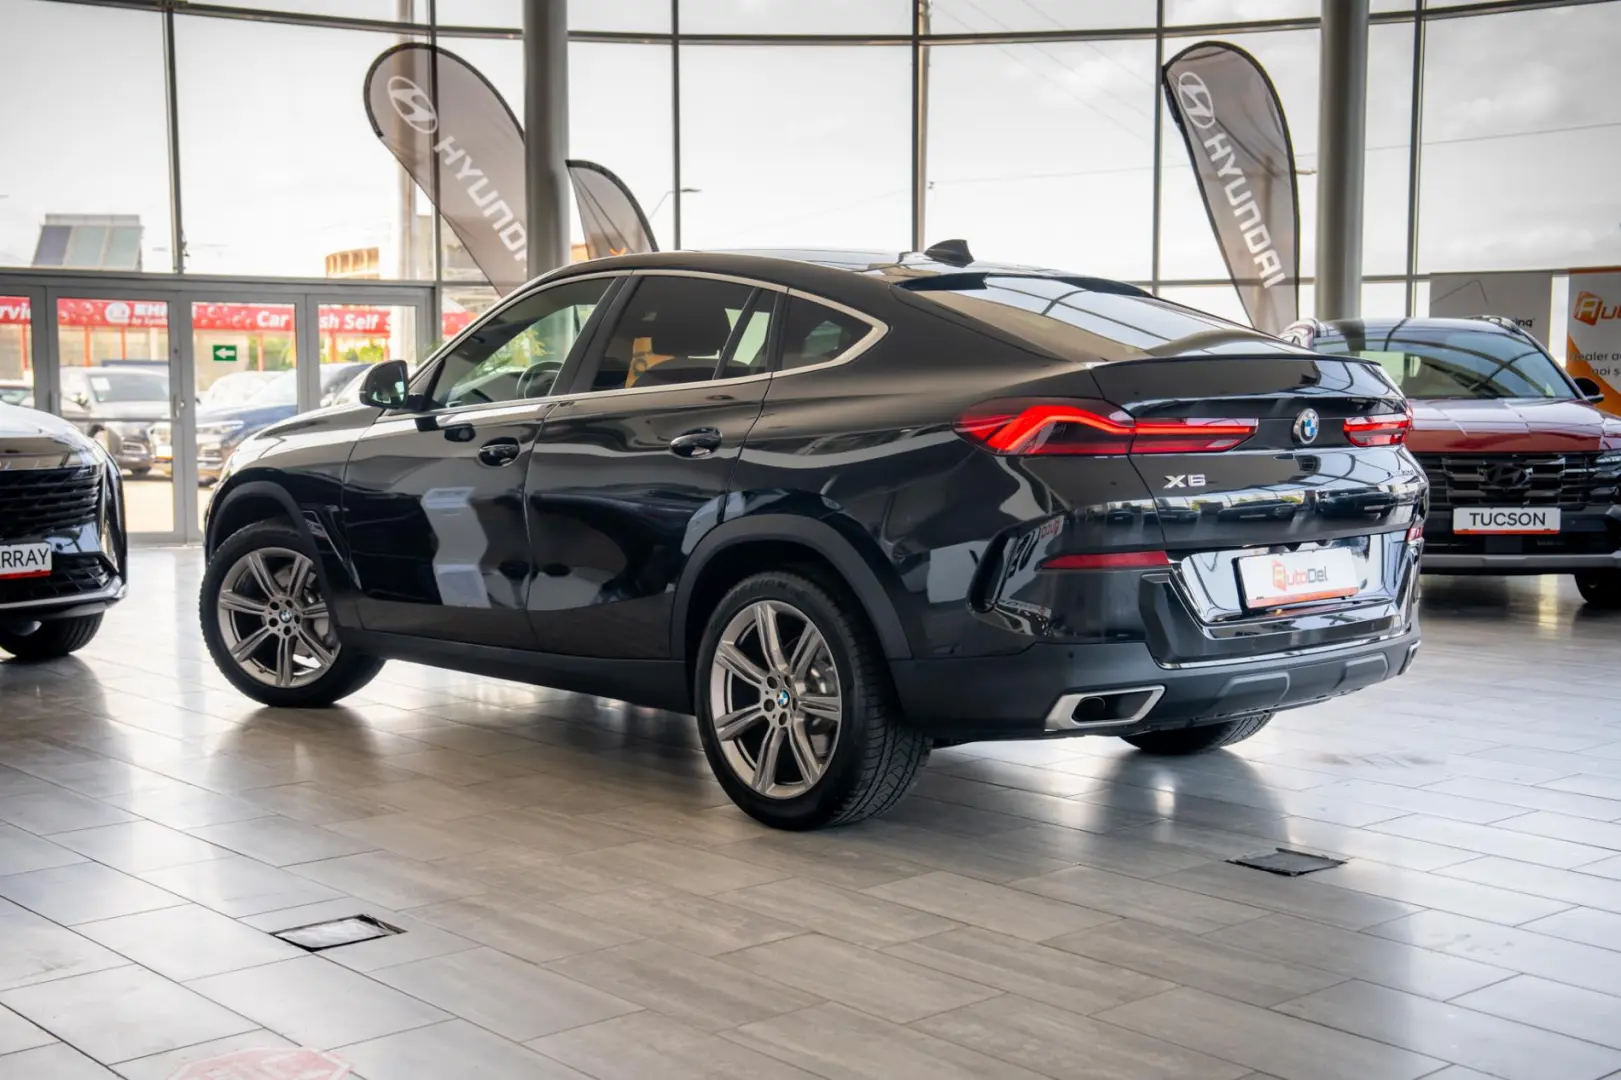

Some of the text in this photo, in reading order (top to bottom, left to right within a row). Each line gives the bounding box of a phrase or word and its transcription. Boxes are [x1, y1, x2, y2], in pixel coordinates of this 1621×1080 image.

[1204, 132, 1286, 288] HYUNDAI
[257, 310, 289, 328] Car
[344, 313, 380, 331] Self
[1163, 474, 1206, 489] X6
[1469, 512, 1546, 527] TUCSON
[0, 547, 49, 568] RRAY
